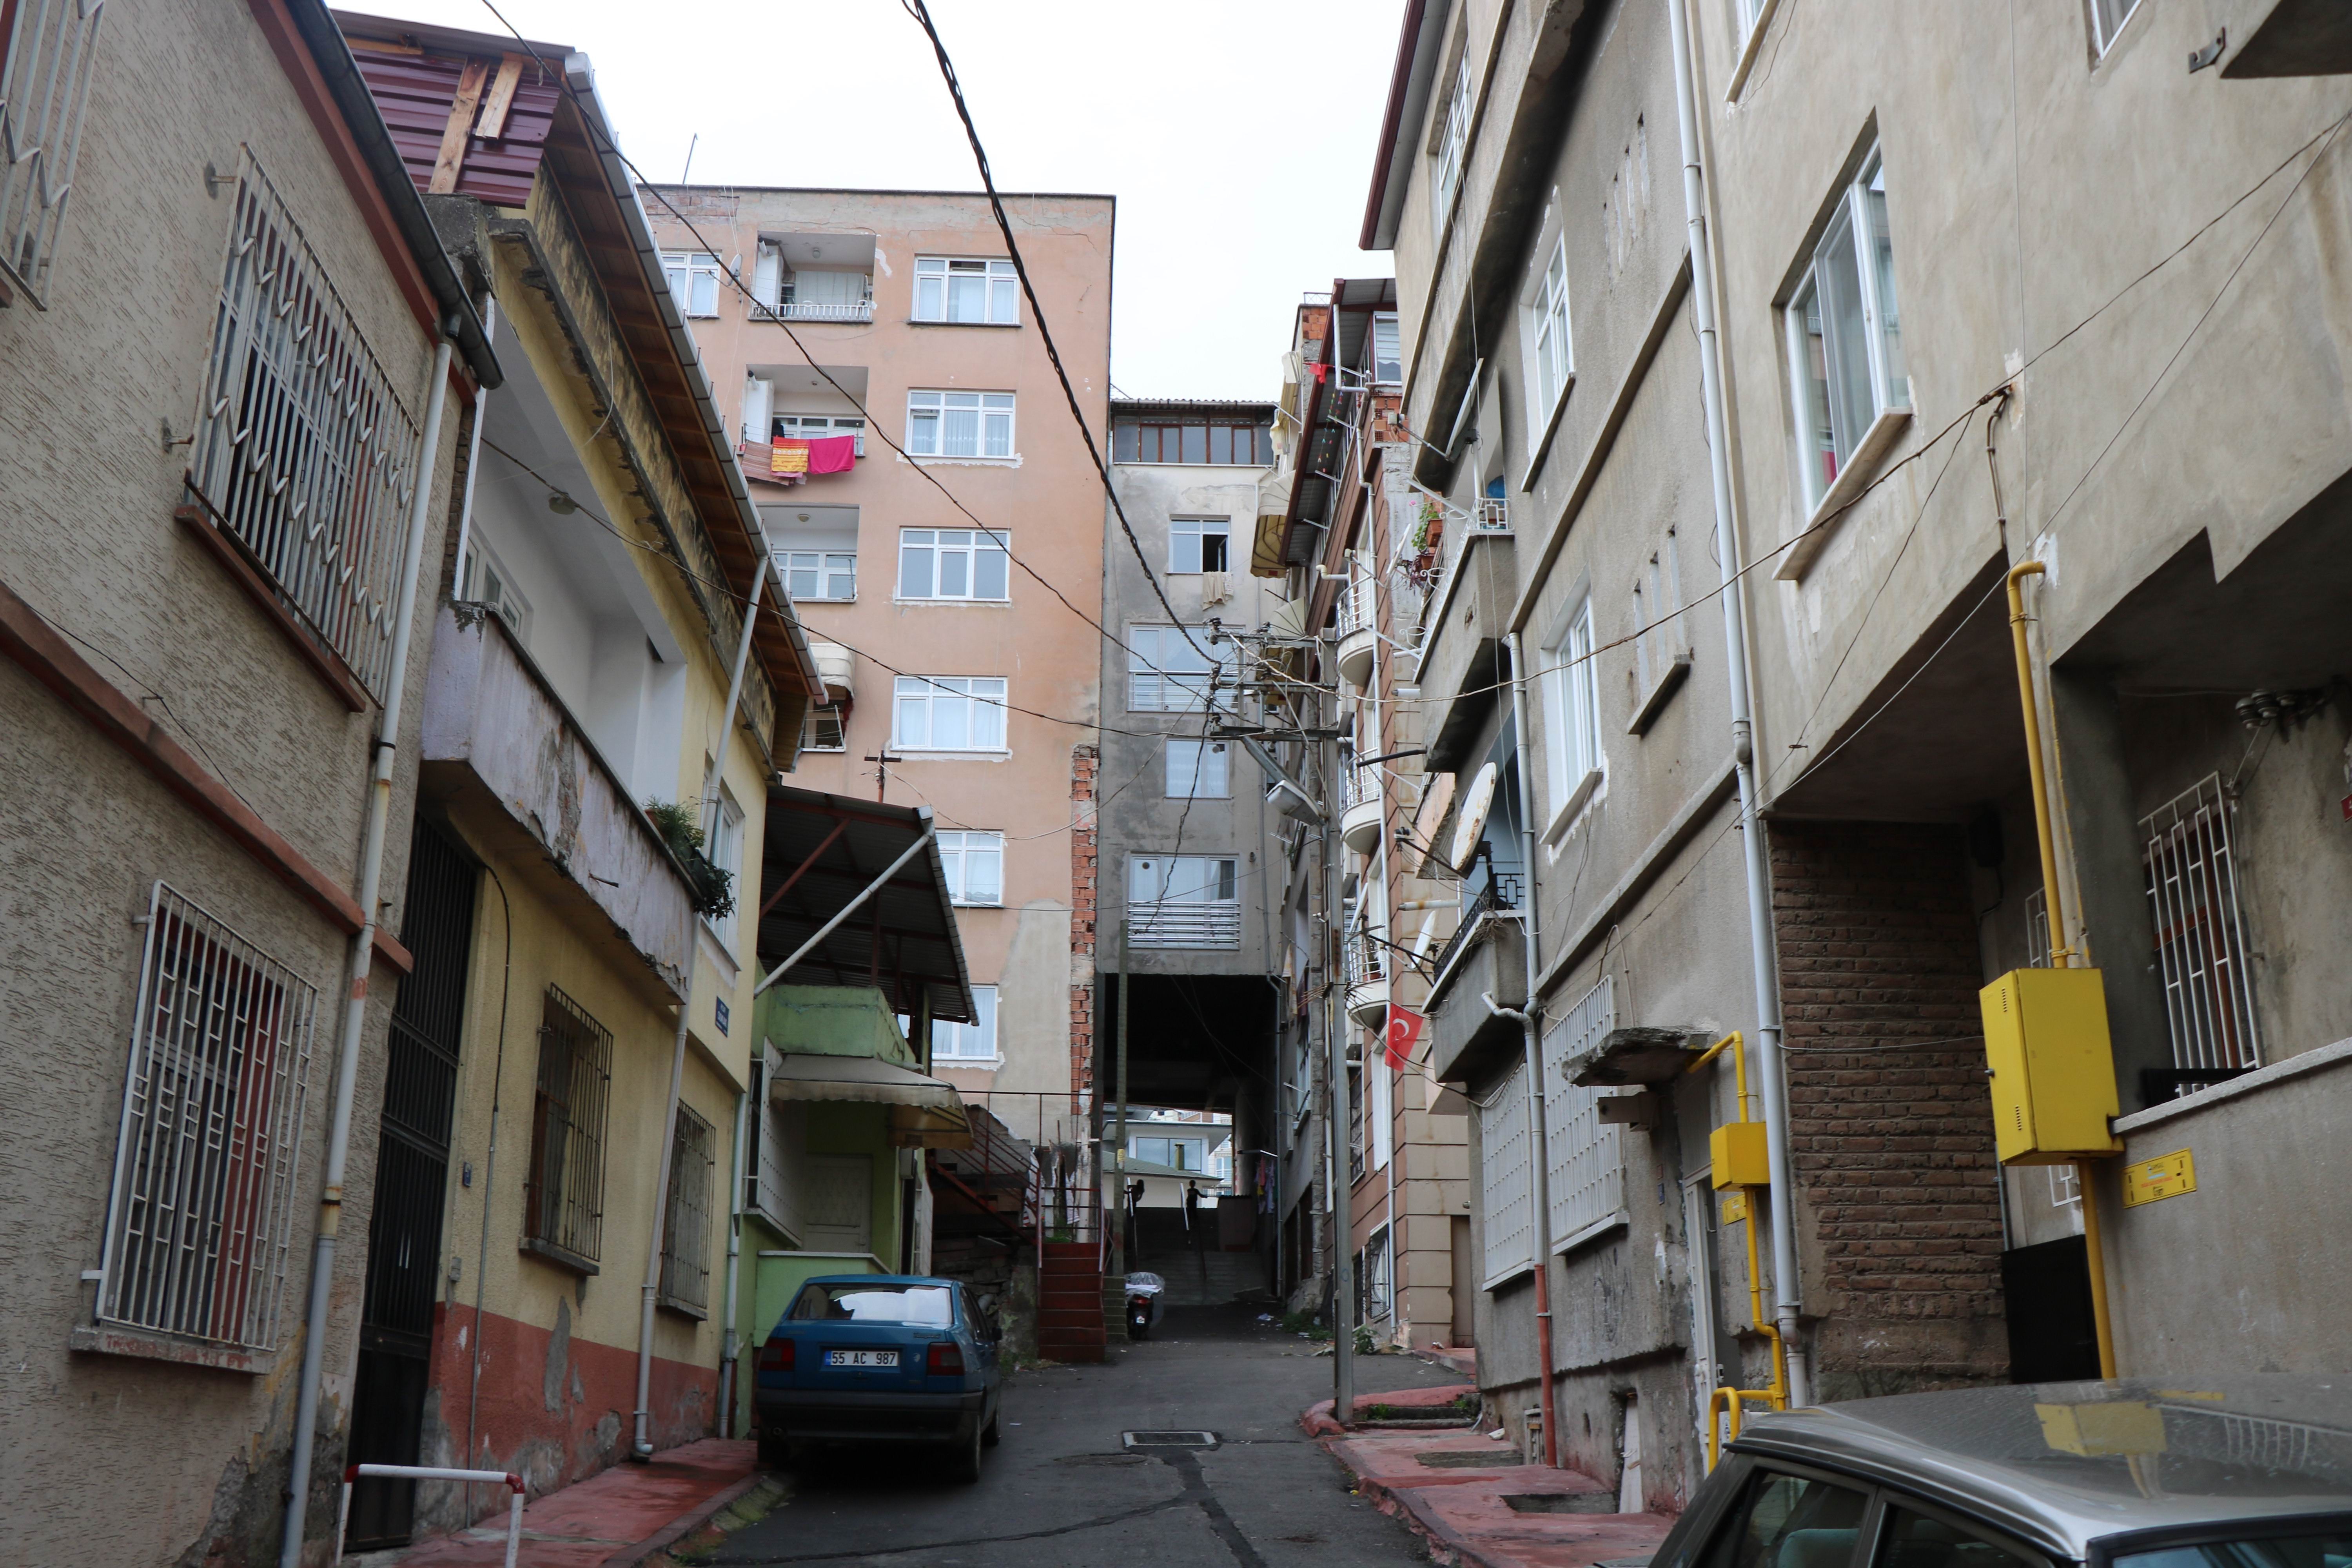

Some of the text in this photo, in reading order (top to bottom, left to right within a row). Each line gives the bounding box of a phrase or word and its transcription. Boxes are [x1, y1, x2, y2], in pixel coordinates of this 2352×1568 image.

[832, 1352, 896, 1365] 55 AC 987
